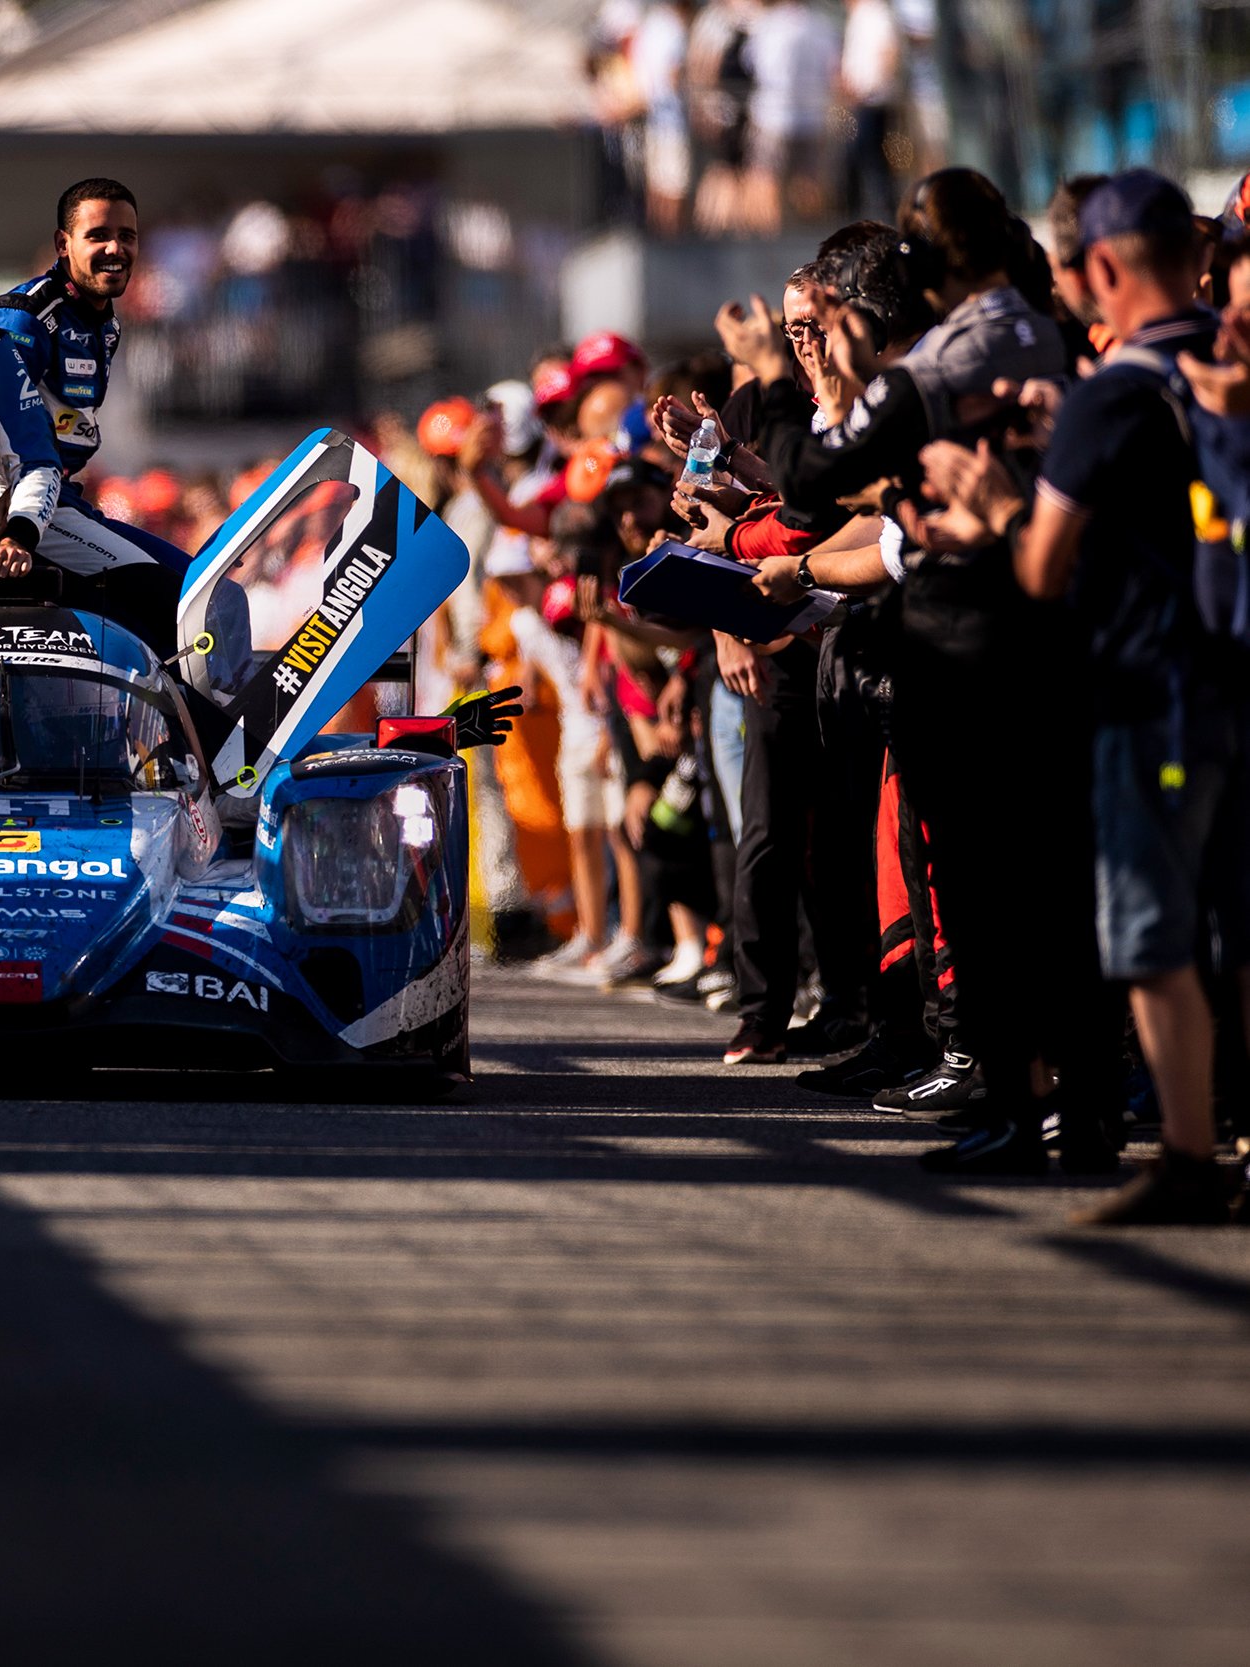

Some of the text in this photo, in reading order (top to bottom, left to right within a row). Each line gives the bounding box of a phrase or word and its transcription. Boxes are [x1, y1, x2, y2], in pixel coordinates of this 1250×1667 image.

[20, 400, 31, 411] LE
[272, 543, 392, 696] #VISITANGOLA
[17, 643, 98, 655] HYDROGEN
[195, 974, 268, 1012] BAI
